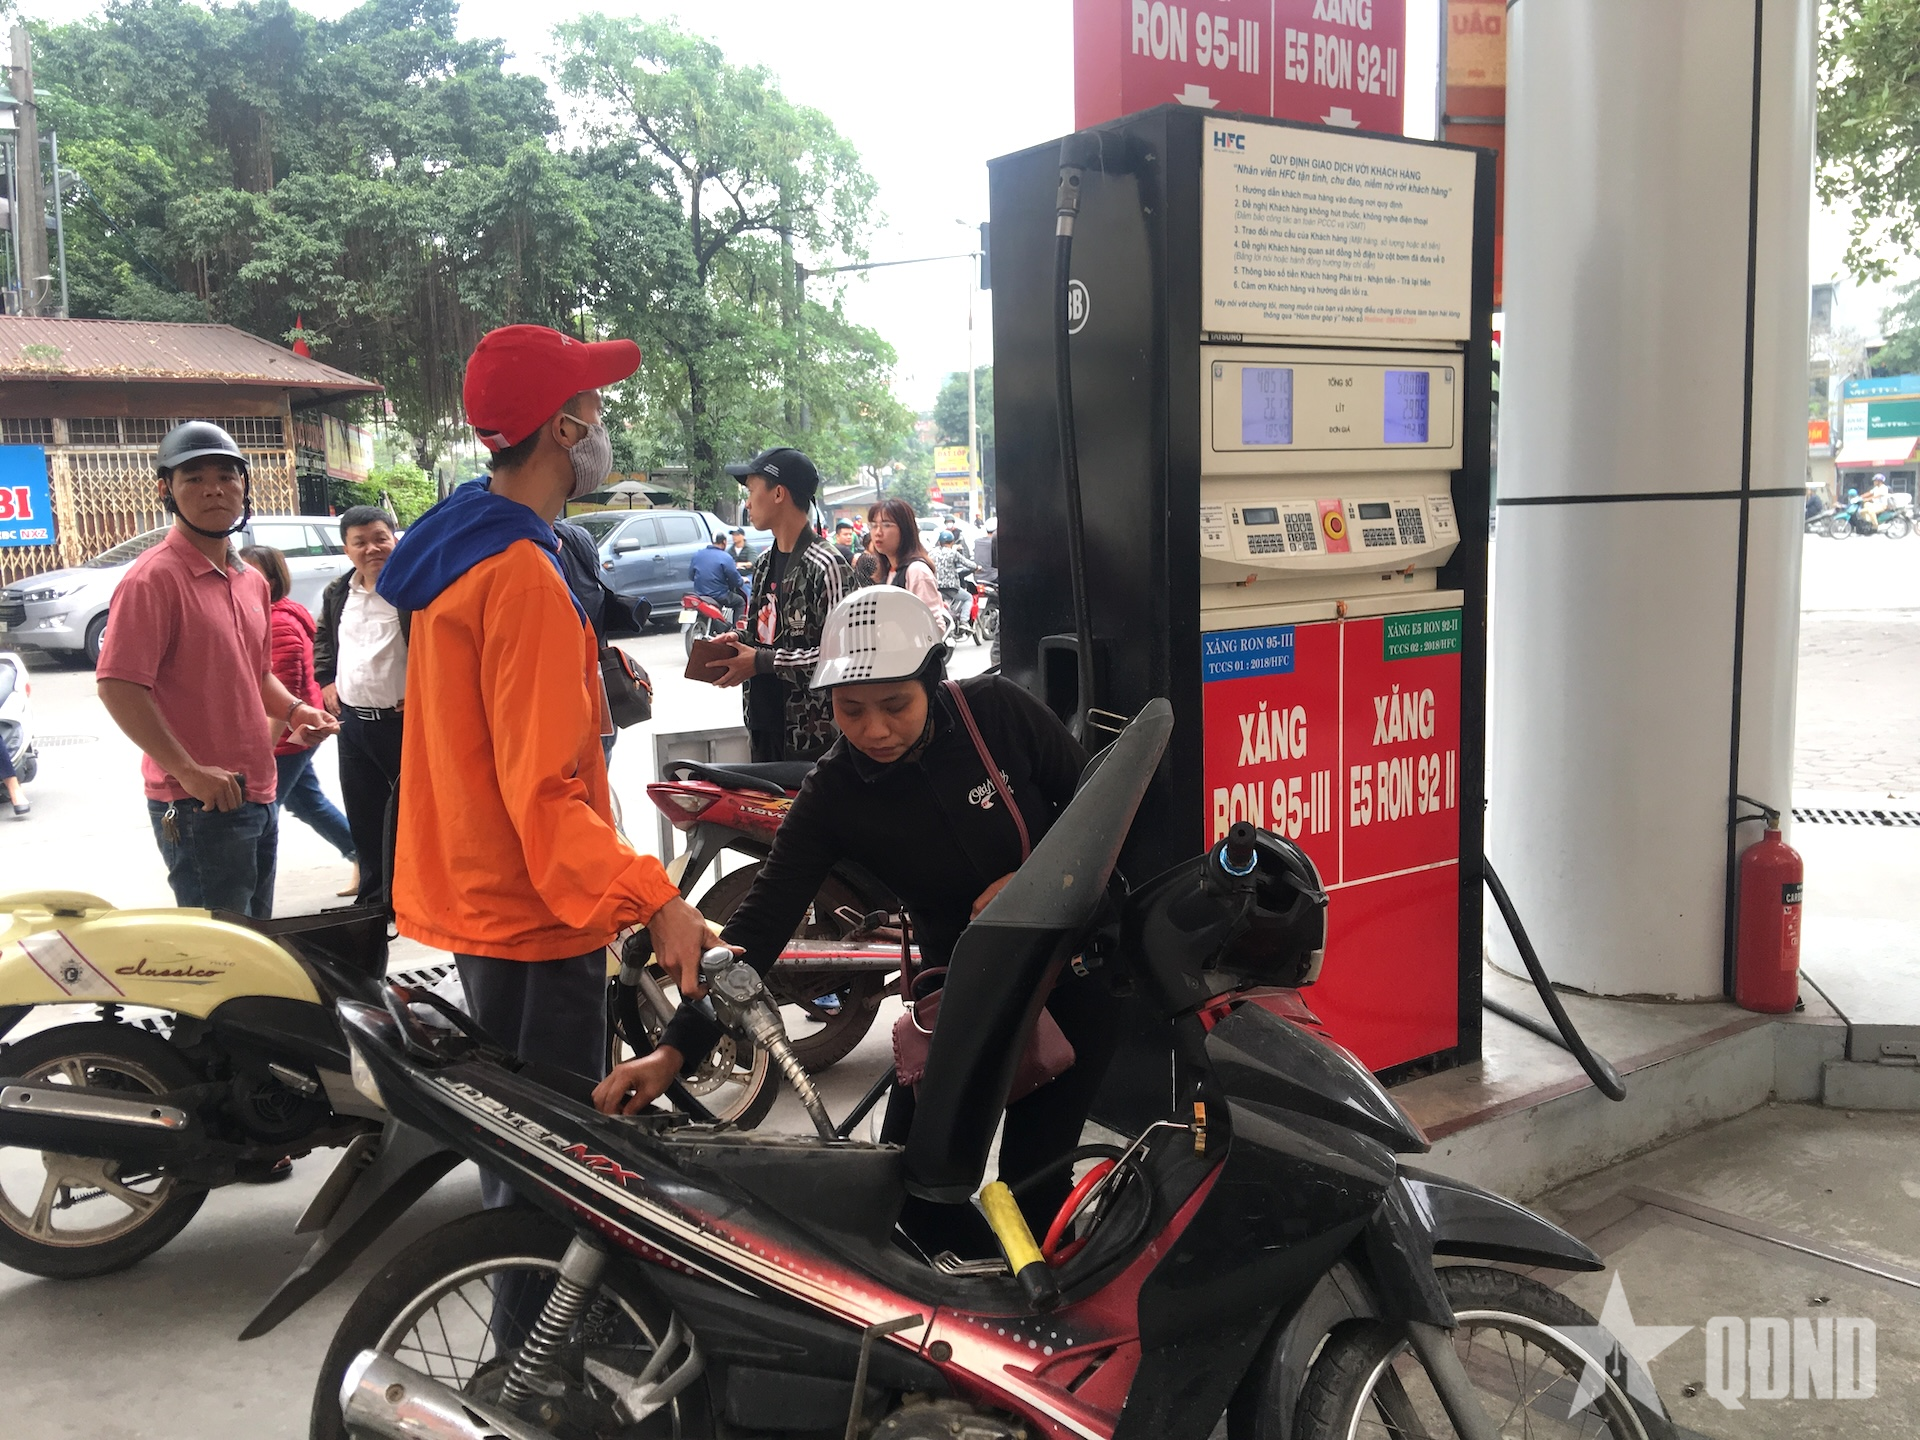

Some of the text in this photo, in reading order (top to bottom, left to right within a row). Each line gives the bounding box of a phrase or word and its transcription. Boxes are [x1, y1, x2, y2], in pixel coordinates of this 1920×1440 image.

[1132, 0, 1259, 74] RON 95-III
[1285, 28, 1397, 97] E5 RON 92-II
[1214, 131, 1245, 149] HFC
[1269, 154, 1421, 180] QUY ĐỊNH GIAO DỊCH VỚI KHÁCH HÀNG
[1279, 169, 1295, 179] HFC
[1412, 623, 1421, 635] E5
[1424, 620, 1440, 634] RON
[1442, 619, 1458, 632] 92-II
[1206, 633, 1294, 655] XĂNG RON 95-III
[1389, 643, 1410, 655] TCCS
[1410, 643, 1419, 652] 02
[1208, 661, 1233, 674] TCCS
[1234, 660, 1244, 671] 01
[1250, 655, 1290, 670] 2018/HFC
[1372, 684, 1435, 747] XĂNG
[1238, 700, 1307, 767] XĂNG
[1350, 764, 1372, 828] E5
[1377, 757, 1413, 822] RON
[1213, 770, 1331, 845] RON 95-III
